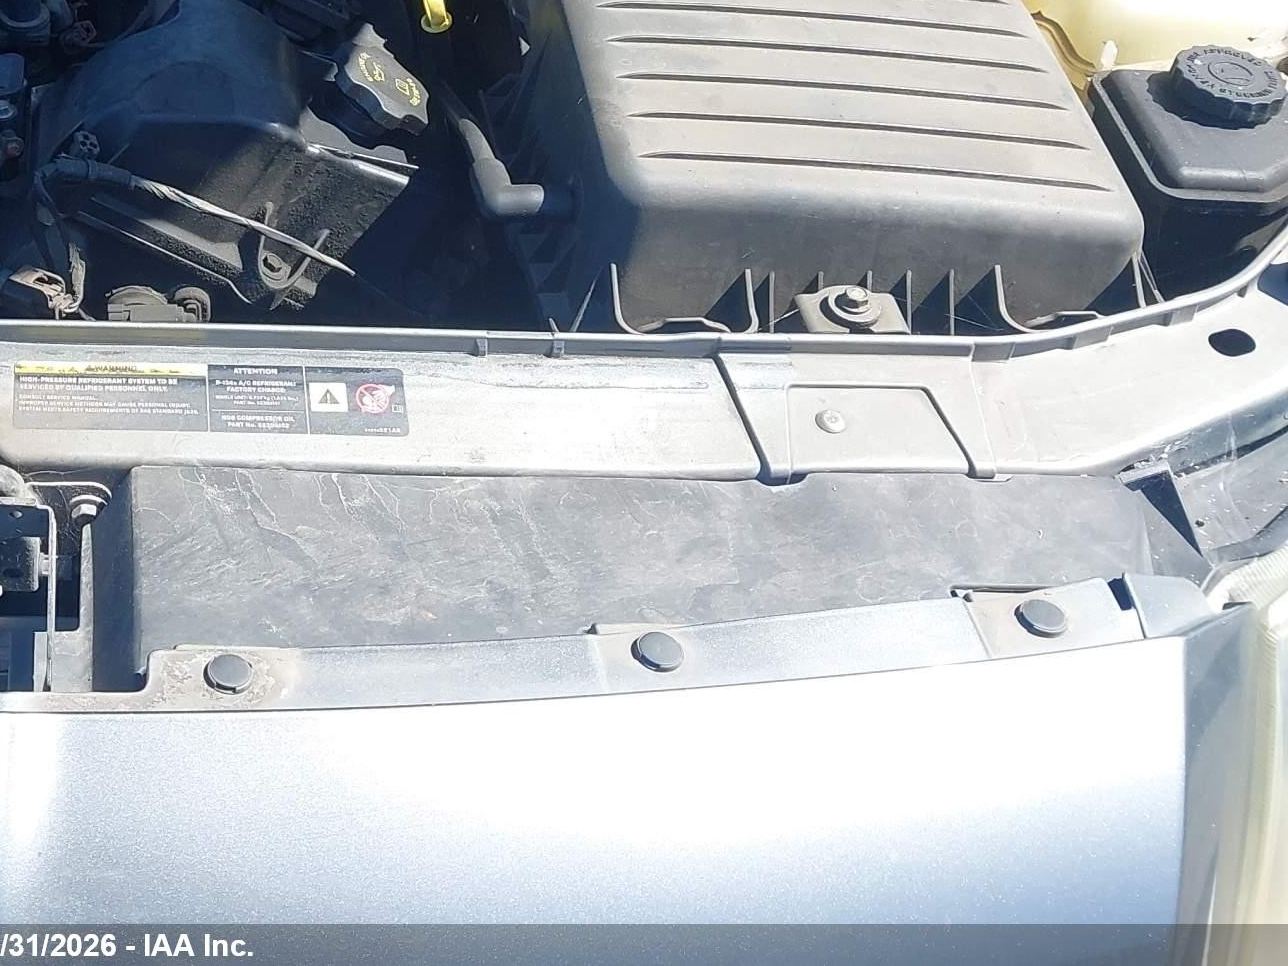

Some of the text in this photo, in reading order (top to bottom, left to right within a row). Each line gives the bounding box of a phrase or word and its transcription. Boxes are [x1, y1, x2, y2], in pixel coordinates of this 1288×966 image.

[233, 367, 278, 376] ATTENTION
[19, 376, 77, 384] HIGH-PRESSURE
[78, 377, 127, 385] REFRIGERANT
[19, 383, 54, 391] SERVICED
[65, 384, 103, 392] QUALIFIED
[236, 415, 283, 423] COMPRESSOR
